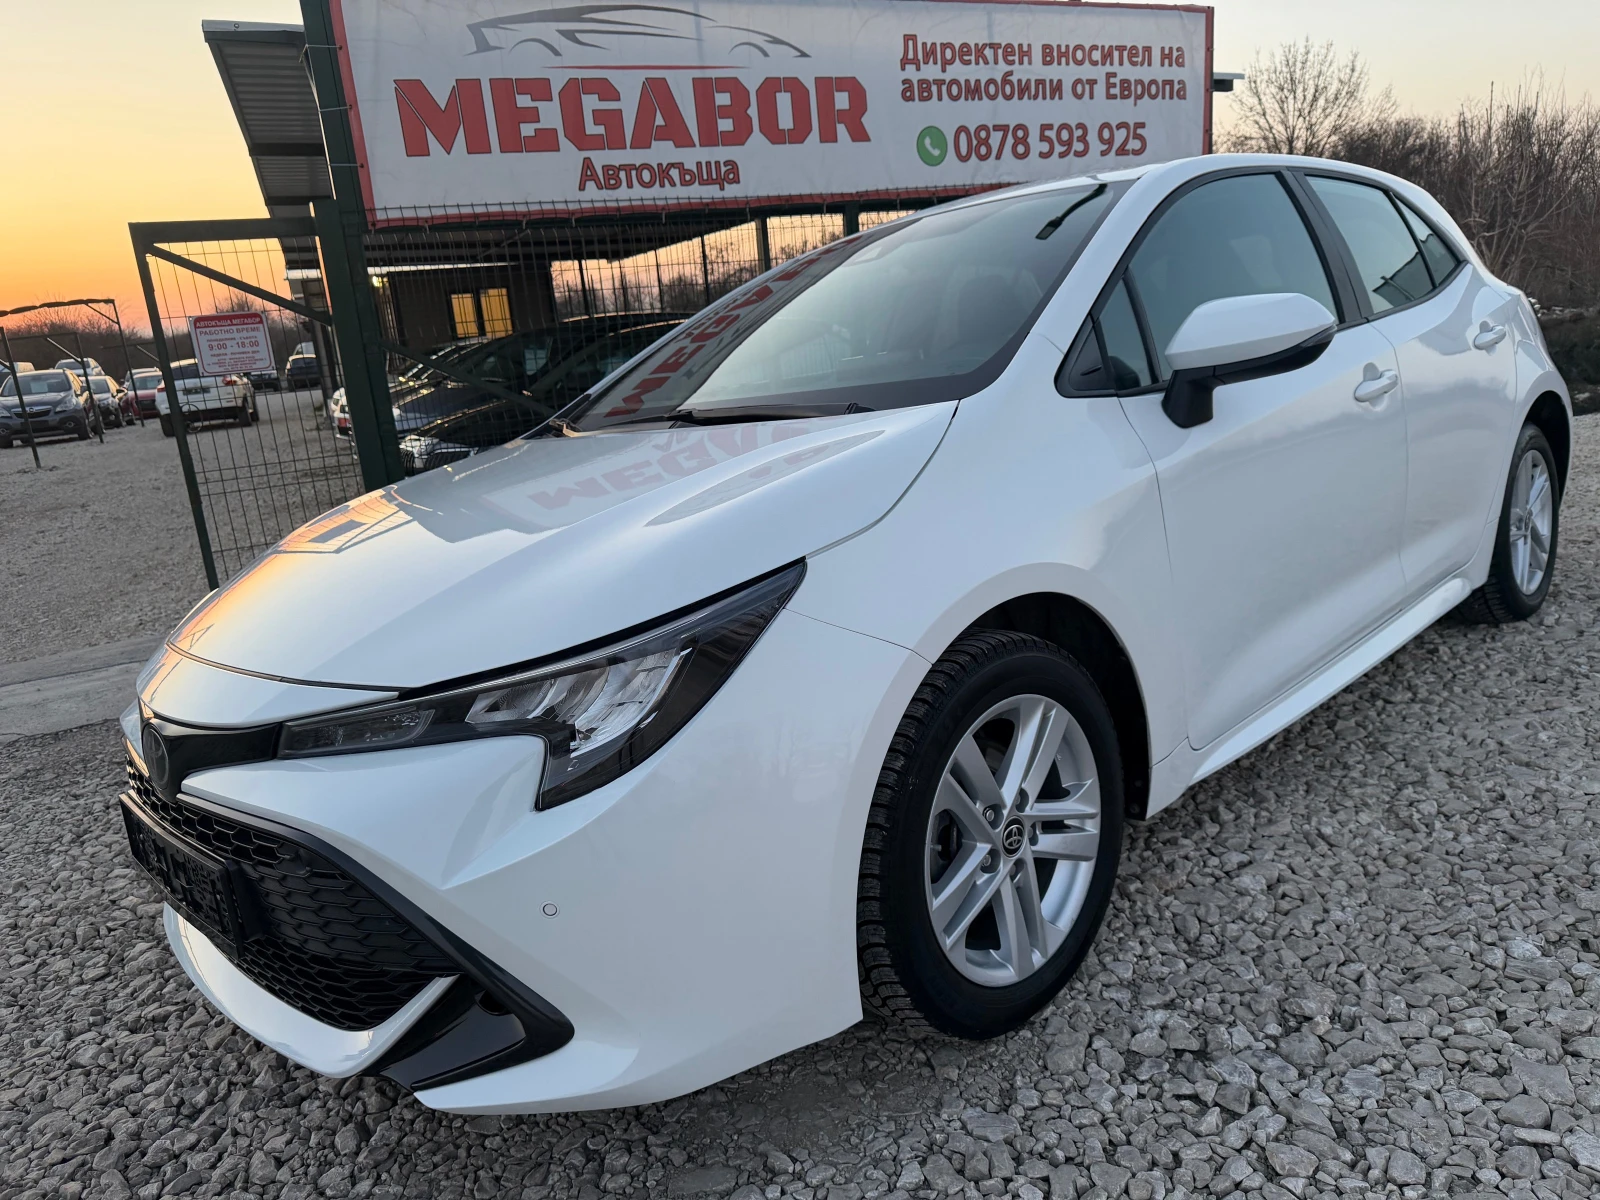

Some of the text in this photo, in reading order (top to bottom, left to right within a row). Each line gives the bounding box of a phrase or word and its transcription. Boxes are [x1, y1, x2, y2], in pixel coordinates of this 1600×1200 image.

[900, 34, 1186, 73] Директен вносител на
[901, 70, 1188, 107] автомобили от Европа
[393, 77, 872, 157] MEGABOR
[953, 121, 1148, 163] 0878 593 925
[578, 157, 741, 192] Автокъща
[196, 317, 261, 328] АВТОКЪЩА МЕГАБОР
[199, 326, 261, 336] РАБОТНО ВРЕМЕ
[208, 342, 228, 351] 9:00
[236, 340, 260, 348] 18:00
